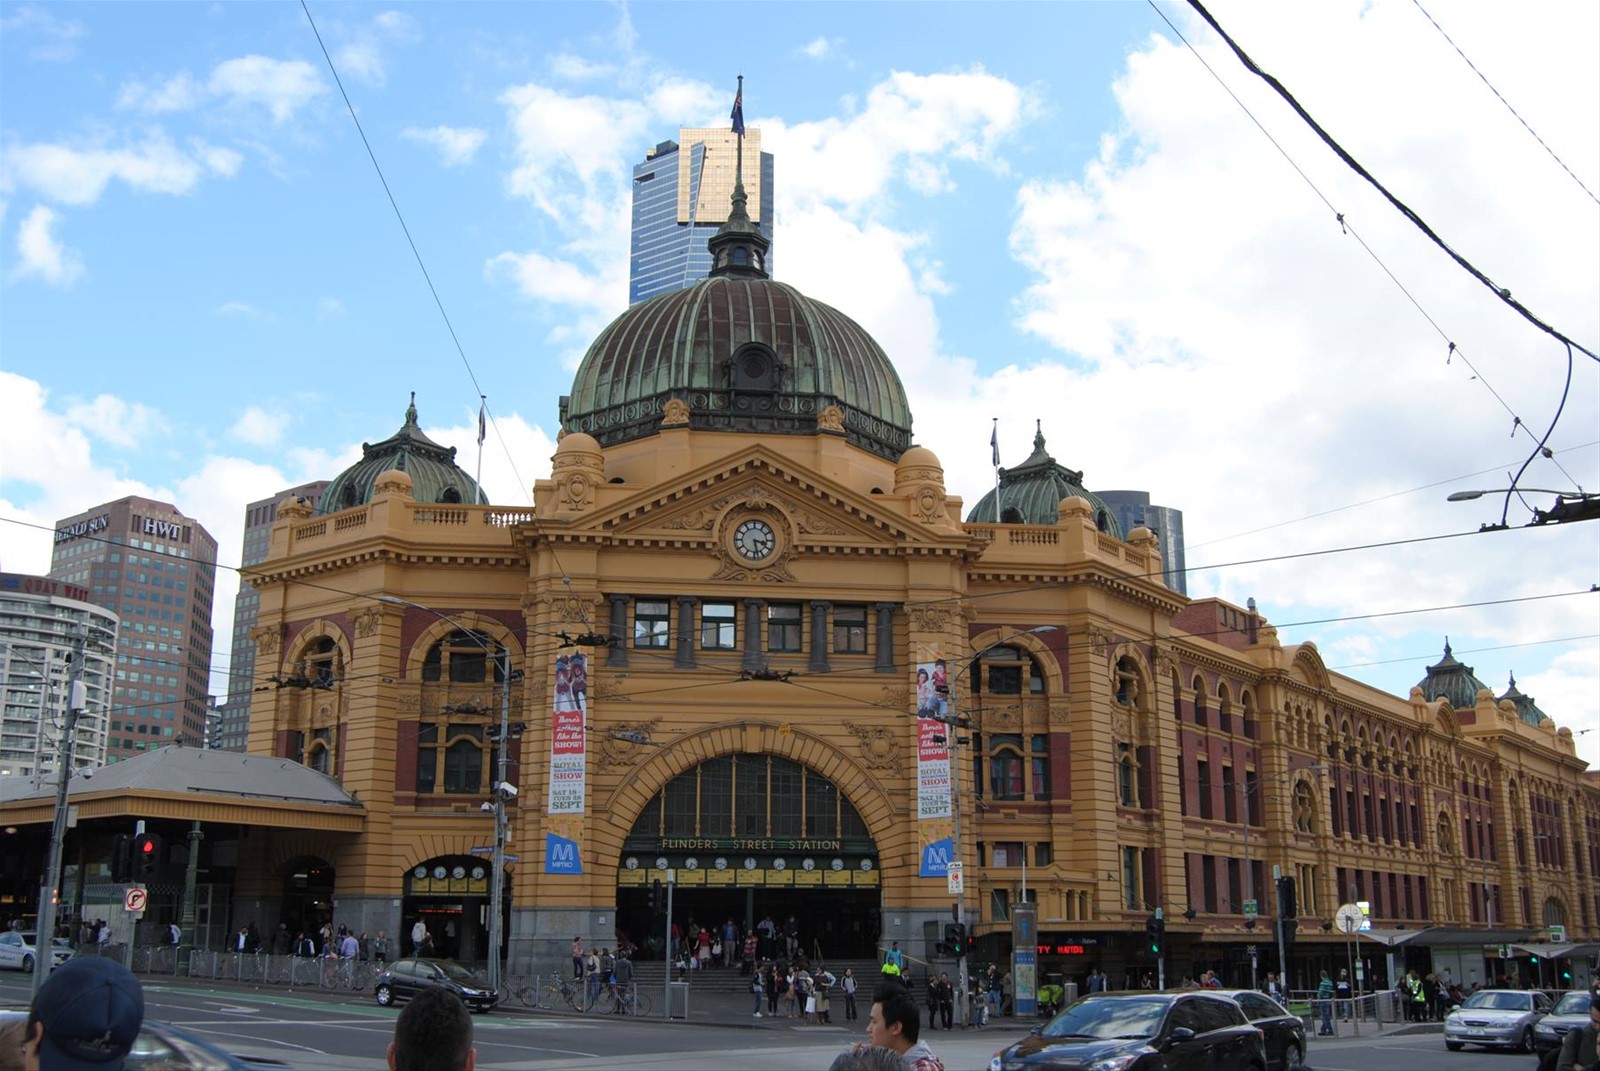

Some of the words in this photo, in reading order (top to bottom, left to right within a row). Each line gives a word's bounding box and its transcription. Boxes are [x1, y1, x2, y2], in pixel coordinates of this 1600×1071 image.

[55, 522, 87, 542] HERALD
[89, 515, 108, 532] SUN
[143, 518, 181, 539] HWT
[24, 578, 58, 594] QUAY
[64, 585, 89, 602] WEST
[552, 801, 582, 810] SEPT
[921, 806, 949, 815] SEPT
[661, 839, 719, 850] FLINDERS
[733, 839, 776, 850] STREET
[789, 839, 840, 850] STATION
